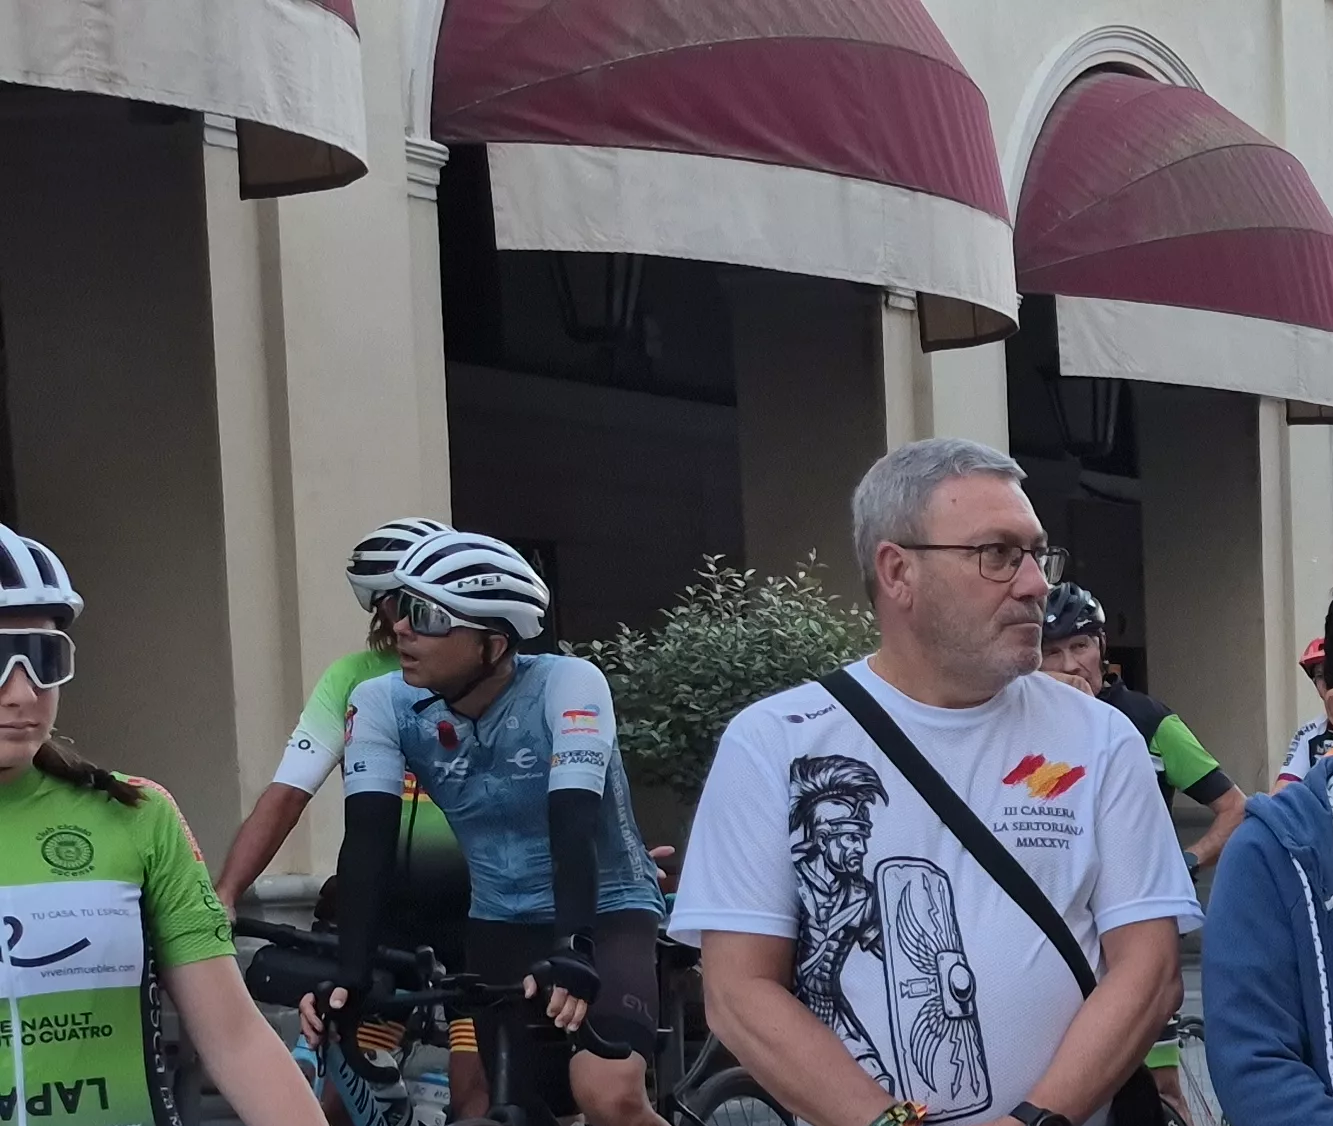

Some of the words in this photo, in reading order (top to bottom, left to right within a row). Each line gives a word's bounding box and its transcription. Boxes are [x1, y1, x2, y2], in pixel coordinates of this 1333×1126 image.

[457, 575, 502, 589] MET
[1004, 807, 1018, 816] III
[1021, 806, 1075, 820] CARRERA
[993, 822, 1009, 833] LA
[1013, 821, 1085, 836] SERTORIANA
[1016, 837, 1070, 850] MMXXVI
[0, 1011, 93, 1034] ENAULT
[39, 1024, 113, 1043] CUATRO
